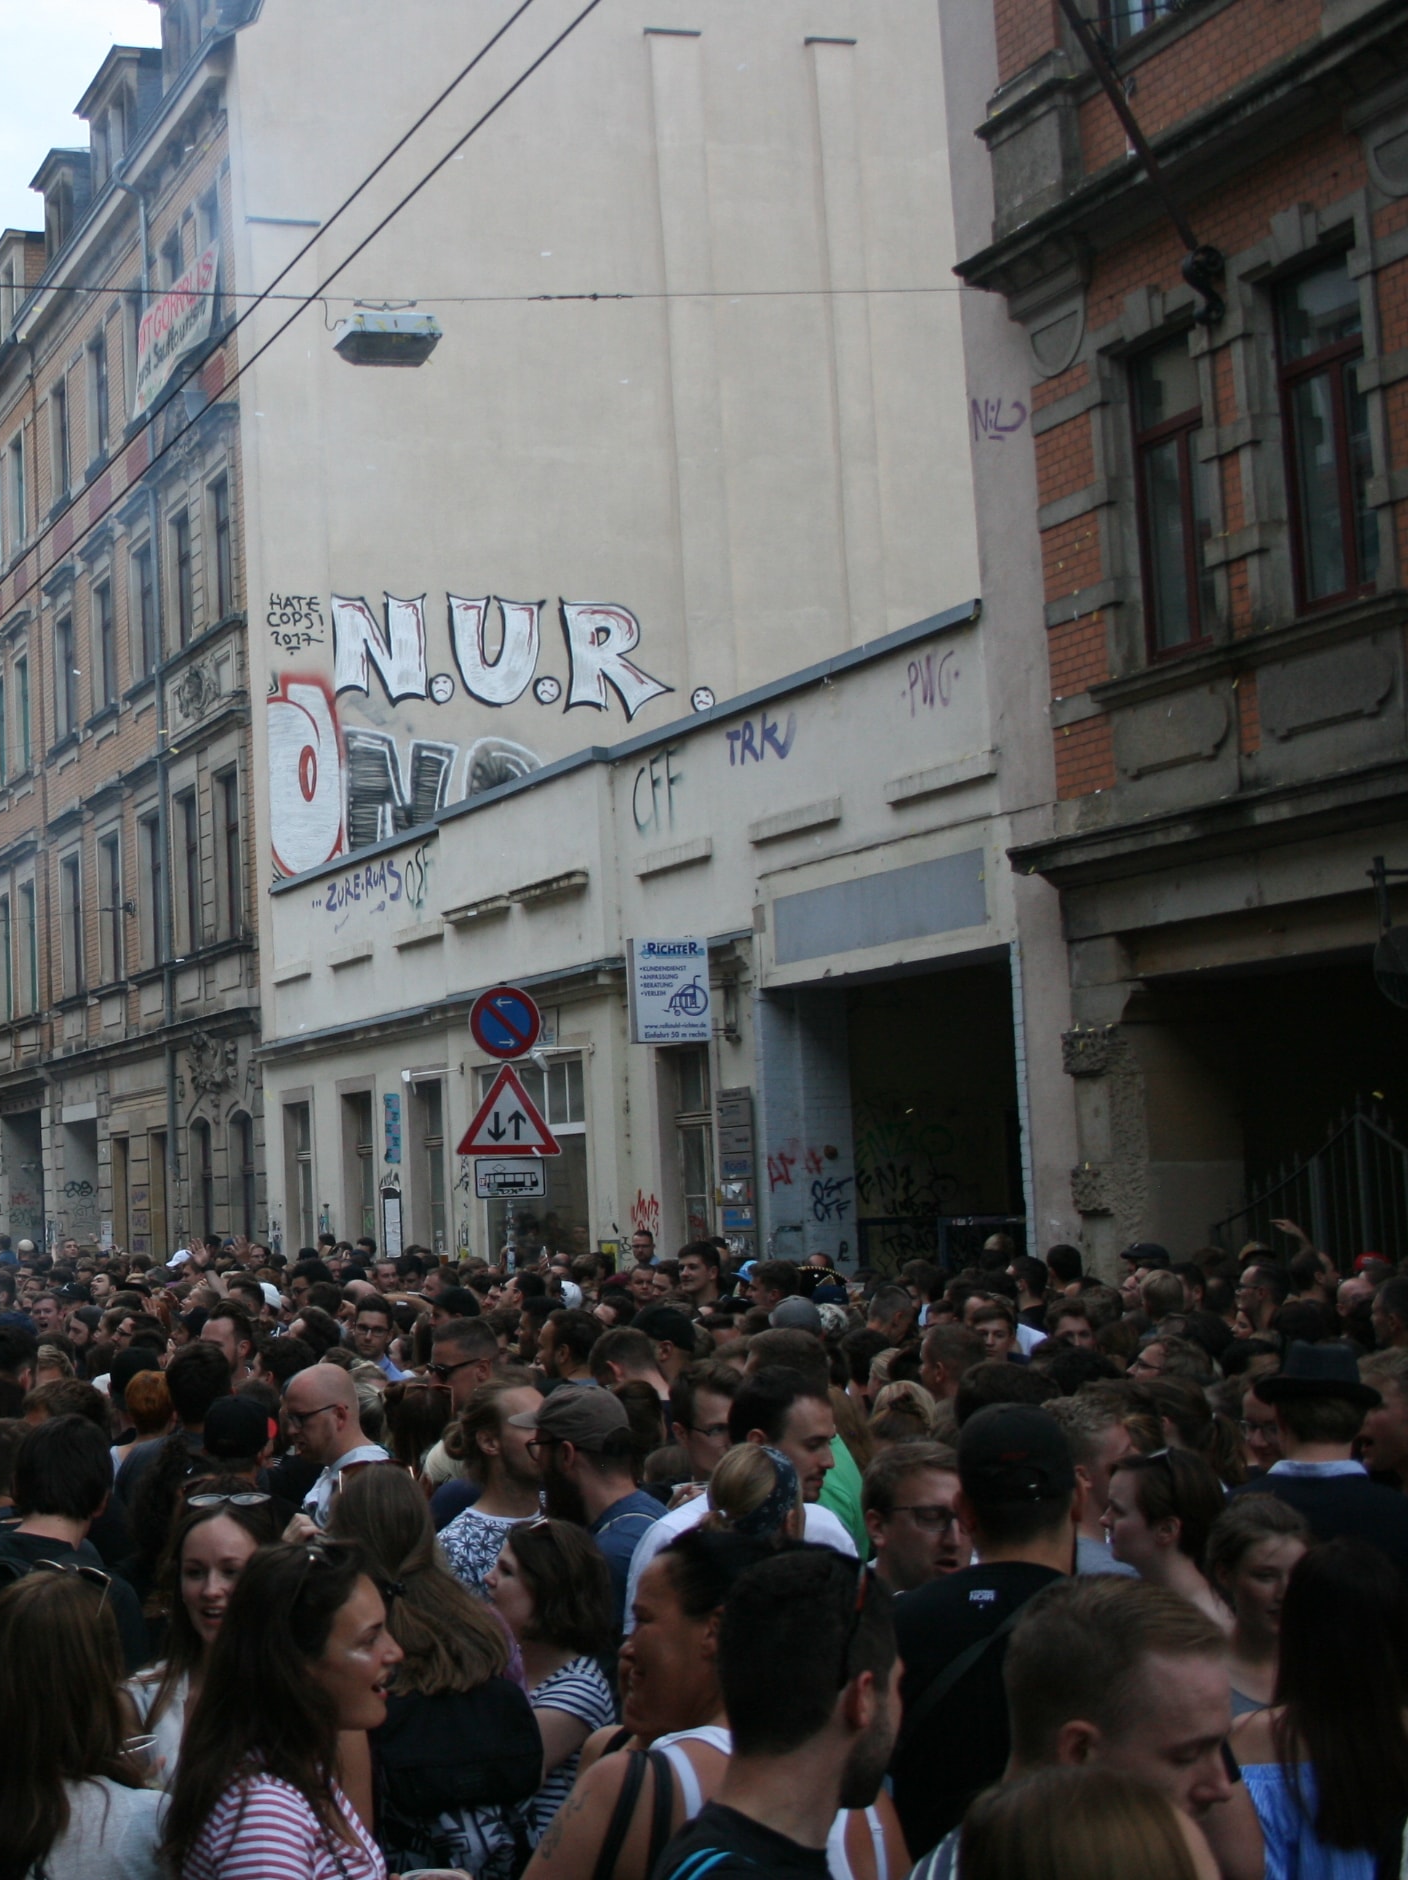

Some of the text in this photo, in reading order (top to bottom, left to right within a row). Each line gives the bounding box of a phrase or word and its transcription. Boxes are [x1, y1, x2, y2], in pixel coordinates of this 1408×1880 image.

[269, 593, 321, 612] HATE
[267, 612, 324, 633] COPS!
[271, 630, 324, 648] 2017
